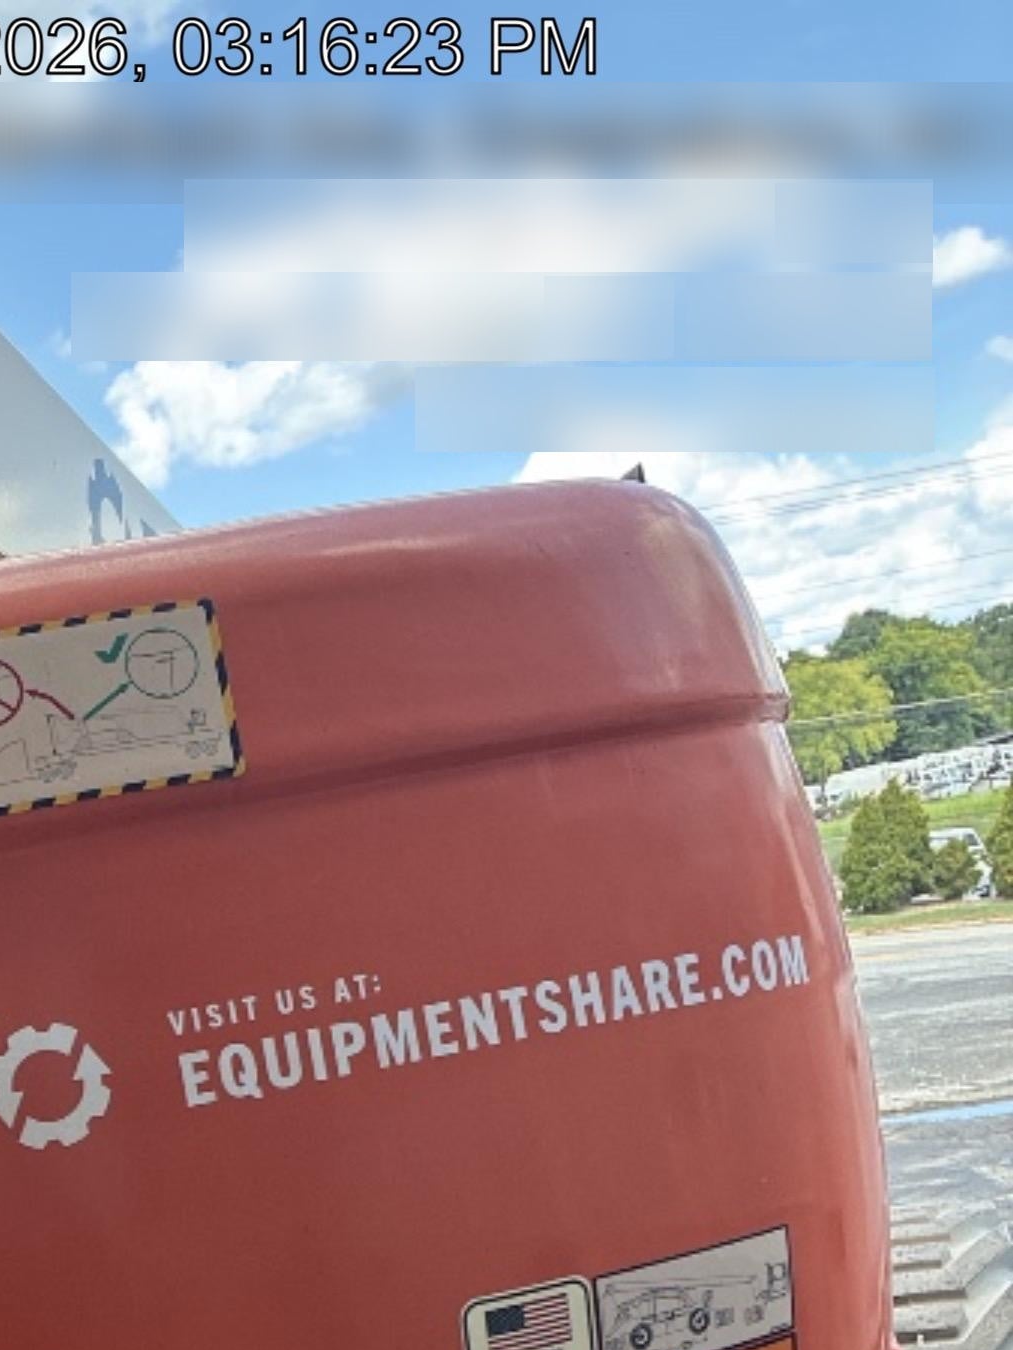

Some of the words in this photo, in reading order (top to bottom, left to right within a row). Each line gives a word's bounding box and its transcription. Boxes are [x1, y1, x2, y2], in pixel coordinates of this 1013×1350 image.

[166, 996, 258, 1037] VISIT
[274, 985, 318, 1016] US
[333, 973, 382, 1004] AT:
[177, 934, 811, 1108] EQUIPMENTSHARE.COM
